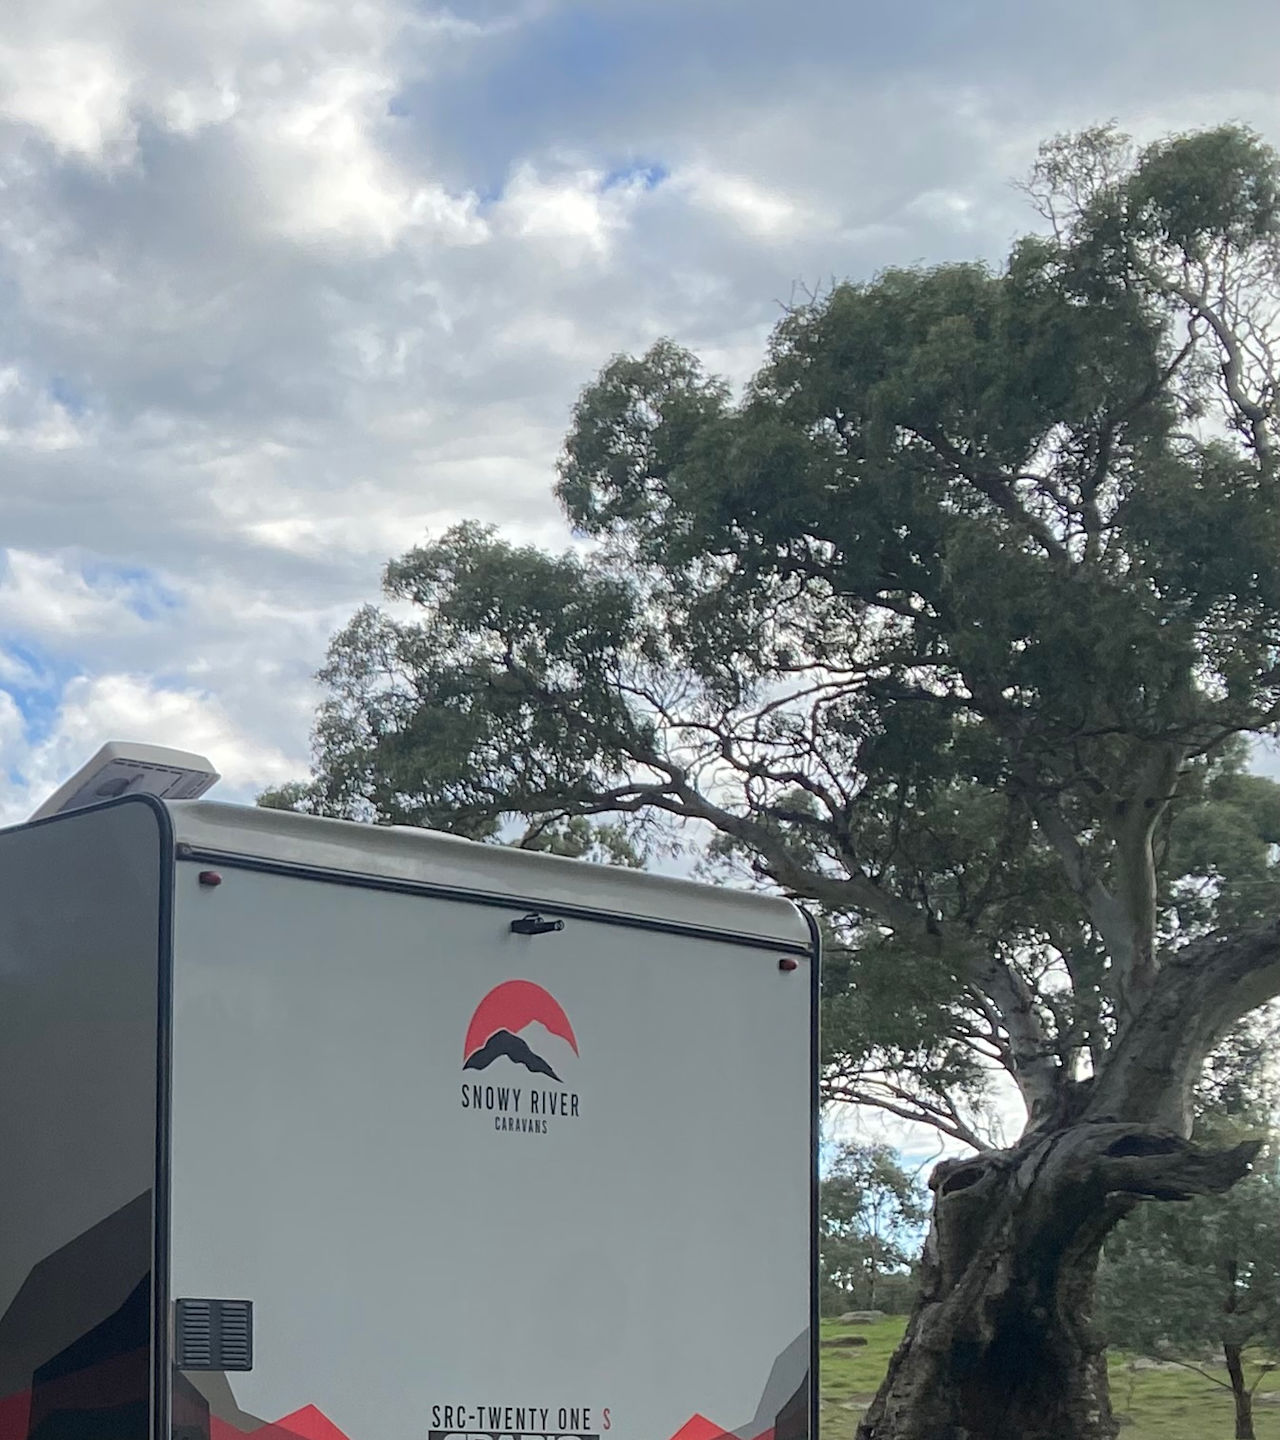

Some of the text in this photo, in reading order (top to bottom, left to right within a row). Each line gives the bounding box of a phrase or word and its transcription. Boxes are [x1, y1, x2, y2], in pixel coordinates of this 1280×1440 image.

[461, 1084, 579, 1117] SNOWY RIVER
[495, 1116, 548, 1134] CARAVANS
[432, 1405, 611, 1430] SRC-TWENTY ONE S
